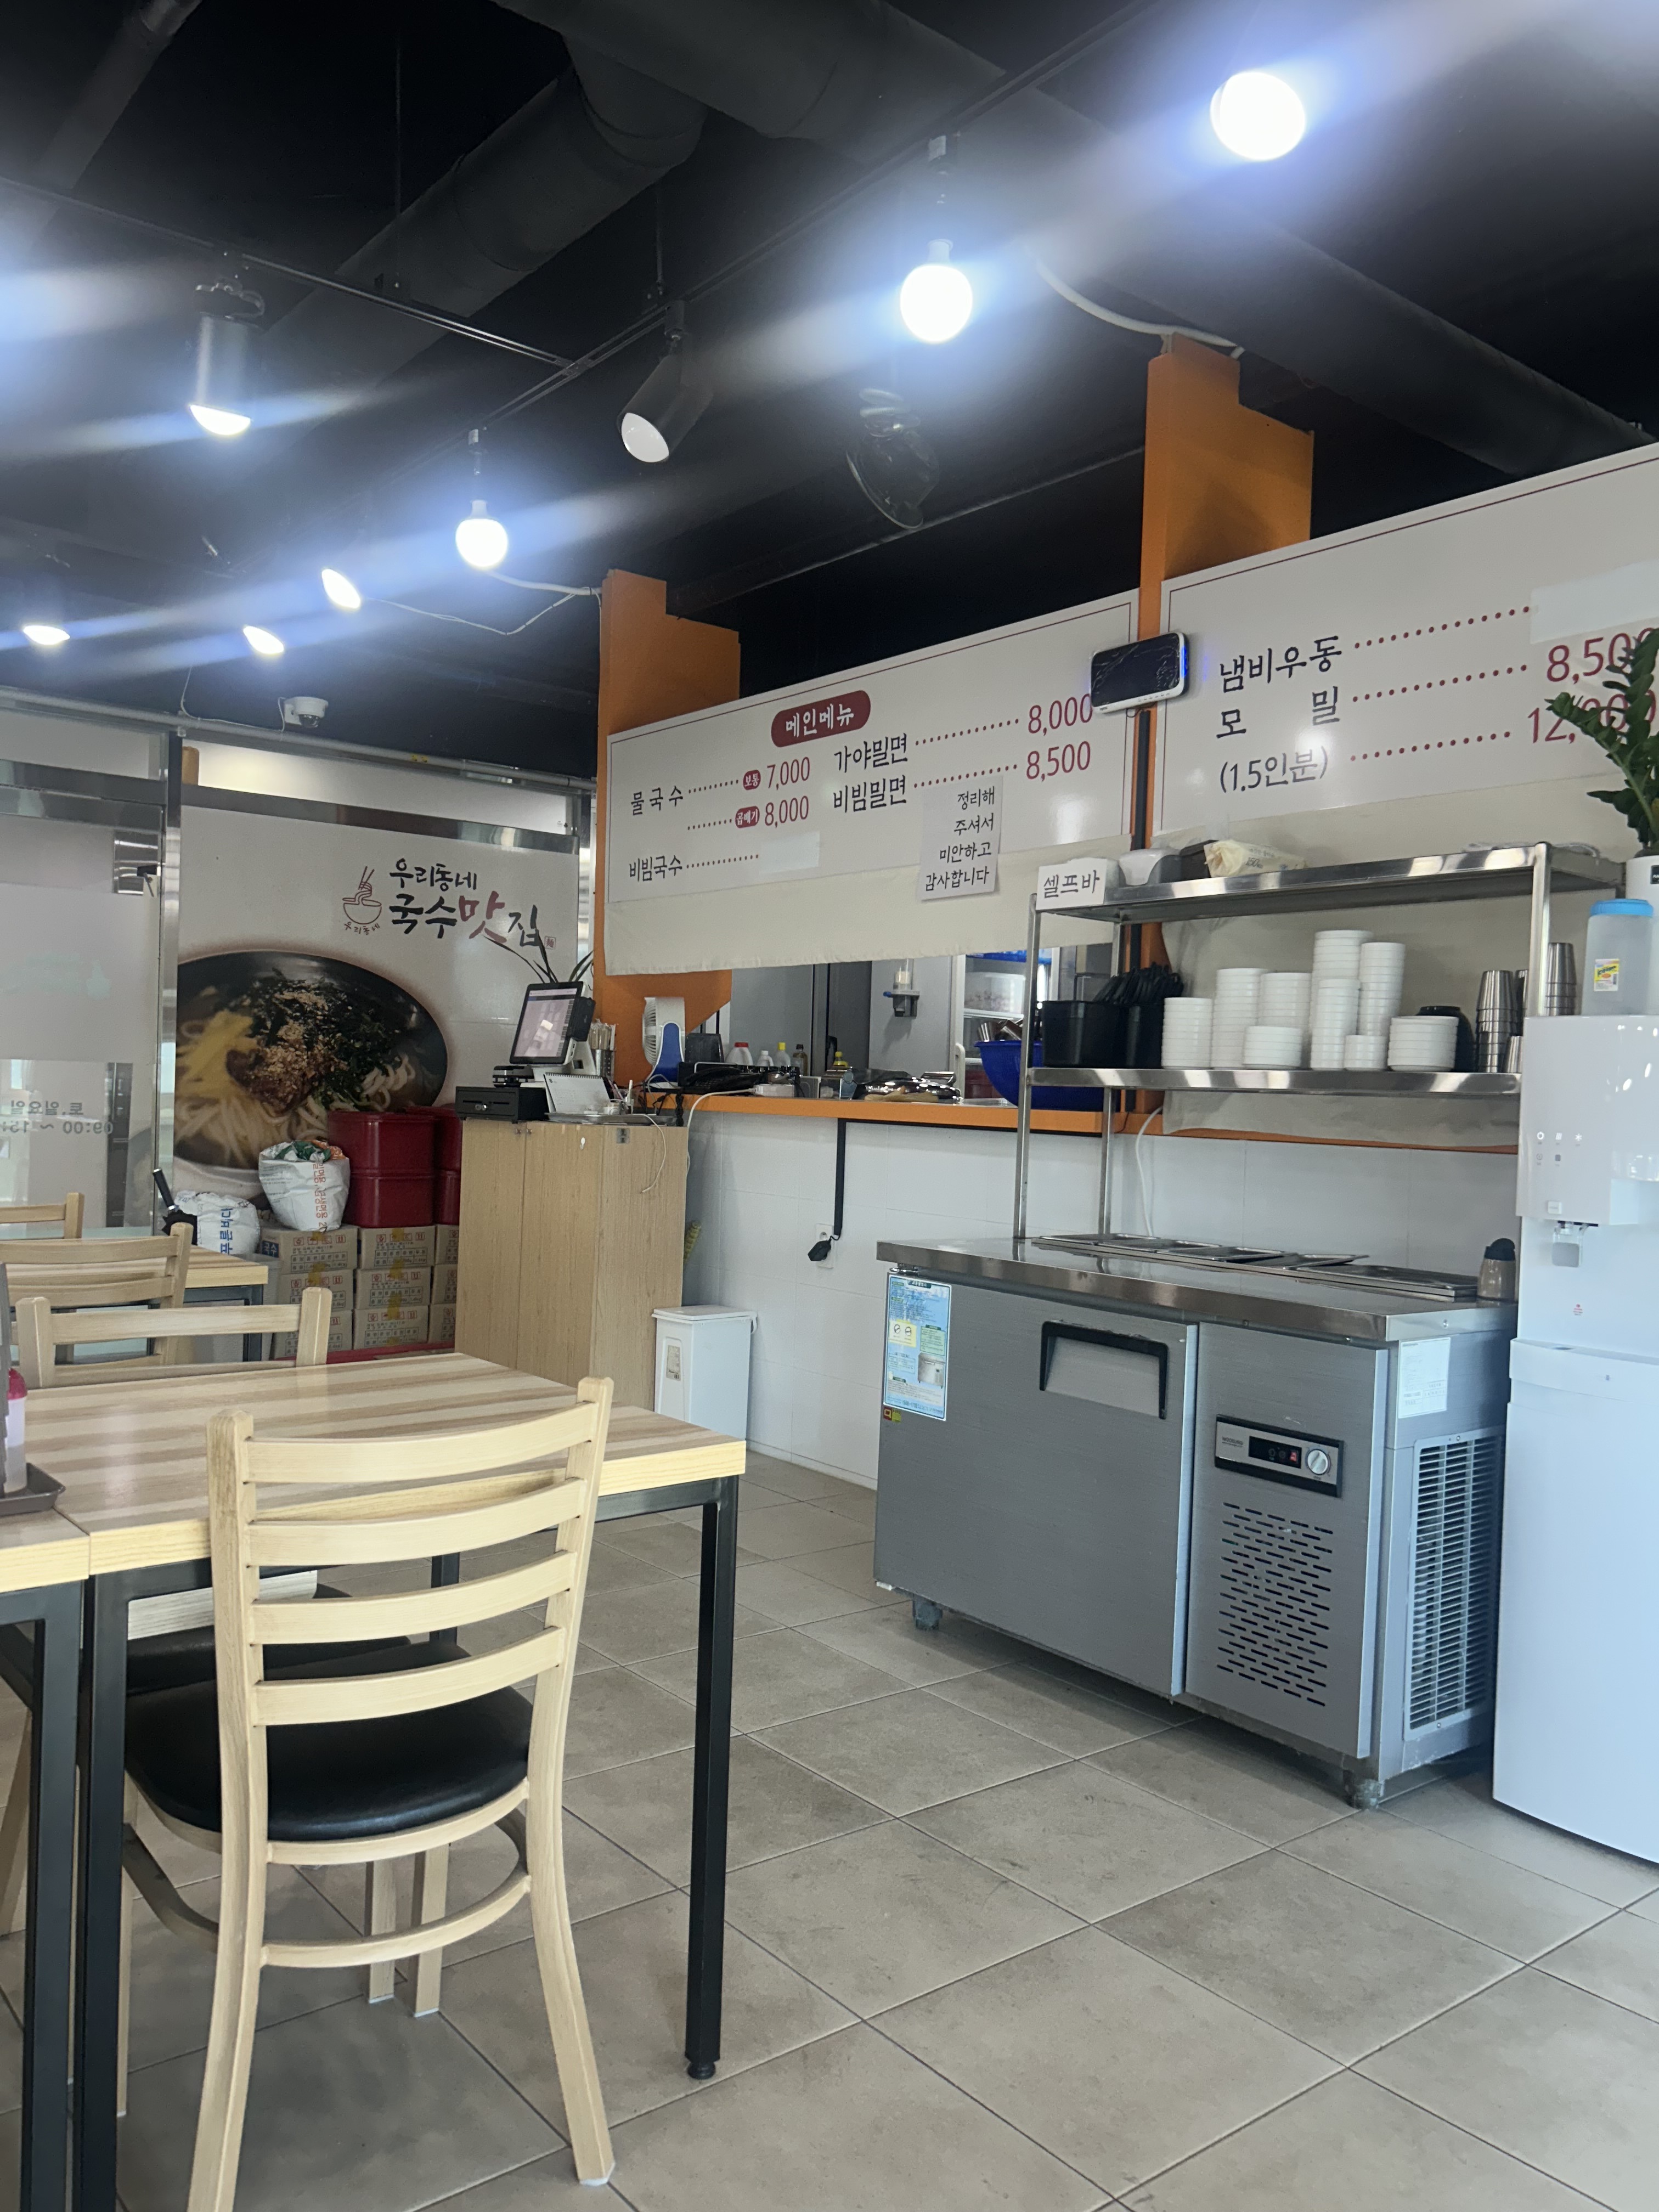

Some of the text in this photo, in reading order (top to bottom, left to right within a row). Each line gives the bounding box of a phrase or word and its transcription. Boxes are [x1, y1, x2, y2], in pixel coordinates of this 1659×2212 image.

[1219, 635, 1342, 693] 냄비우동
[1547, 627, 1655, 685] 8,50
[785, 703, 855, 738] 메인메뉴
[833, 693, 1093, 773] 가야밀면 8,000
[744, 773, 760, 787] 보통
[766, 757, 810, 791] 7,000
[833, 741, 1092, 814] 비빔밀면 8,500
[1219, 745, 1329, 793] (1.5인분)
[764, 795, 809, 828] 8,000
[957, 786, 995, 810] 정리해
[953, 812, 995, 836] 주셔서
[628, 855, 683, 882] 비빔국수
[939, 842, 992, 864] 미안하고
[389, 857, 477, 891] 우리동네
[925, 866, 990, 893] 감사합니다
[1043, 870, 1101, 899] 셀프바
[389, 890, 541, 947] 국수맛집
[220, 1207, 234, 1255] 푸른바다
